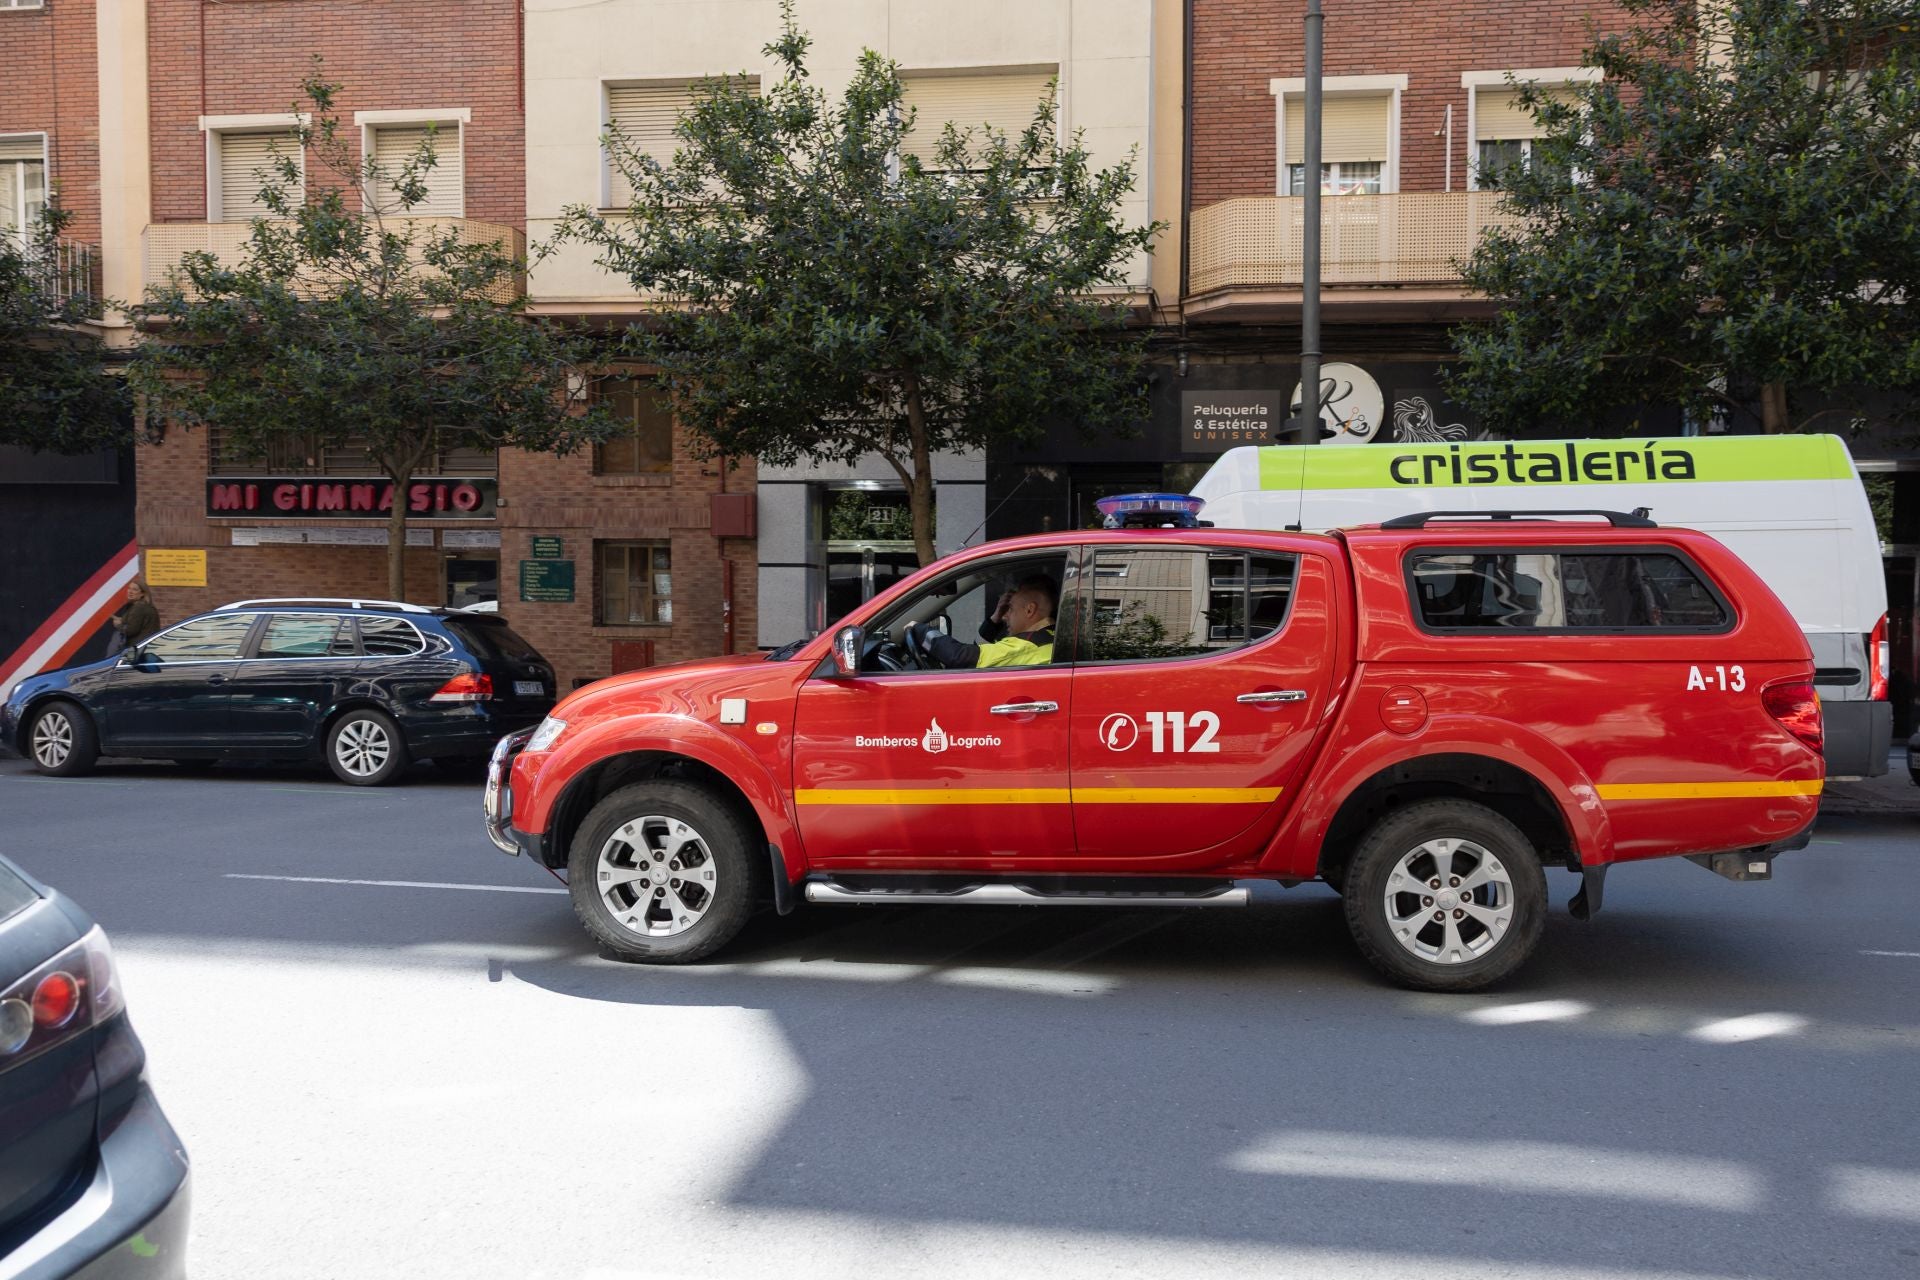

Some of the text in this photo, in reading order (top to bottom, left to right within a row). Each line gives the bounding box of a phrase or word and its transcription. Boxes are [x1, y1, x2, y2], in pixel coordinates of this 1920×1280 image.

[1193, 404, 1268, 418] Peluquería
[1194, 418, 1268, 430] & Estética
[1193, 431, 1268, 440] UNISEX
[1390, 440, 1696, 485] cristalería
[211, 483, 260, 511] MI
[872, 510, 890, 521] 21
[1686, 664, 1746, 692] A-13
[1145, 710, 1221, 753] 112
[855, 735, 1001, 749] Bomberos Logroño
